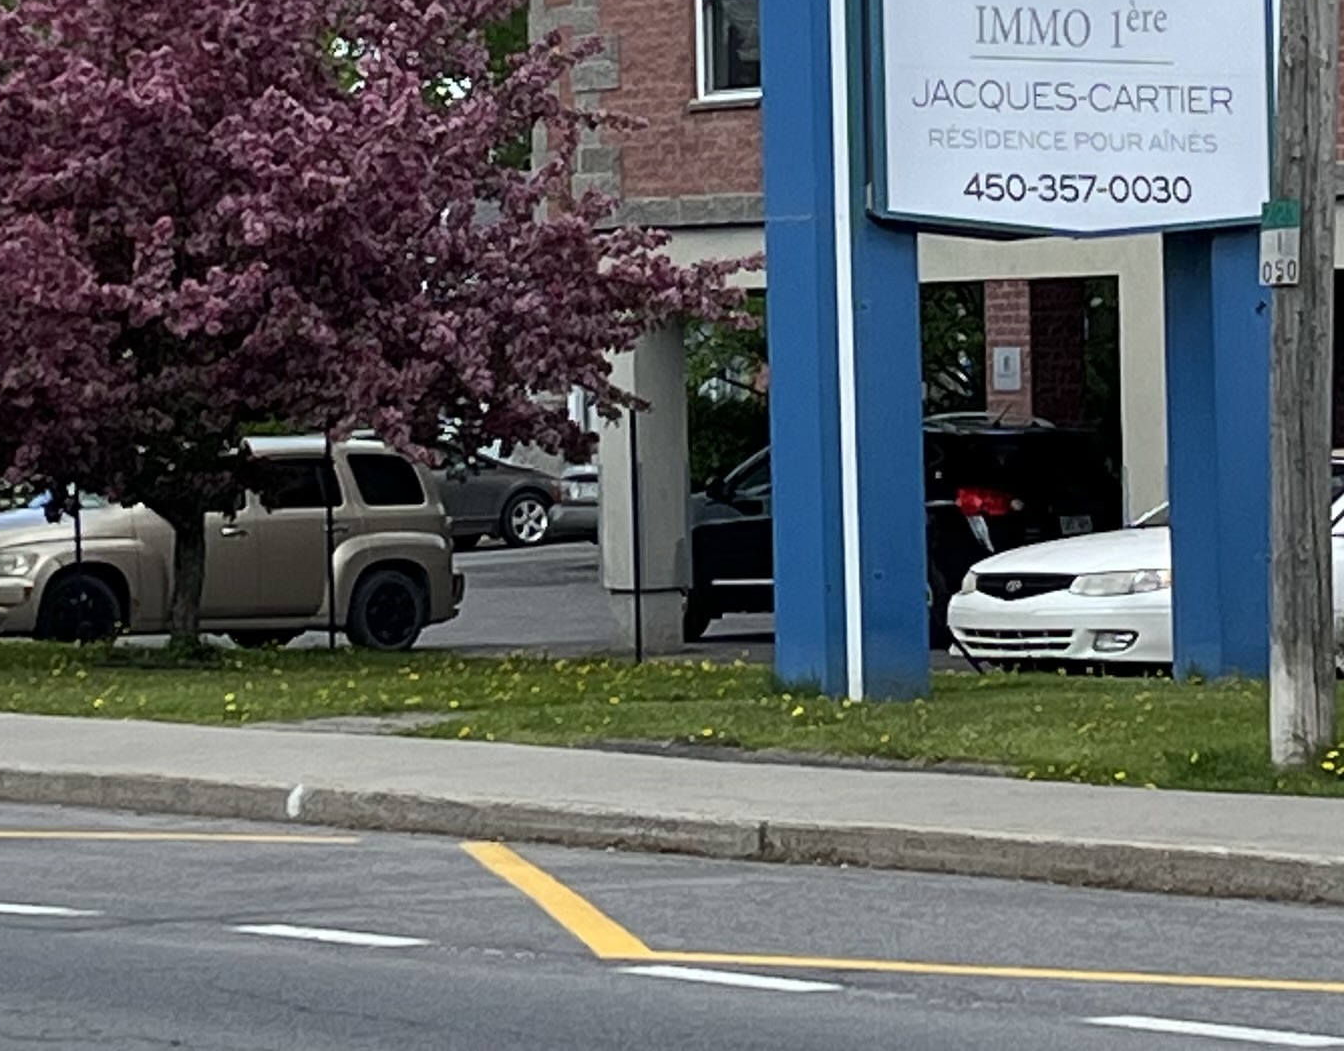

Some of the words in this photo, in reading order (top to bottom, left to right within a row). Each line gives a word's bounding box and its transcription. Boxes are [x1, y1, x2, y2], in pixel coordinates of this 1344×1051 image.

[975, 5, 1092, 48] IMMO
[1109, 0, 1169, 49] 1ère
[911, 79, 1234, 115] JACQUES-CARTIER
[927, 124, 1068, 151] RÉSIDENCE
[1074, 132, 1143, 153] POUR
[963, 172, 1194, 205] 450-357-0030
